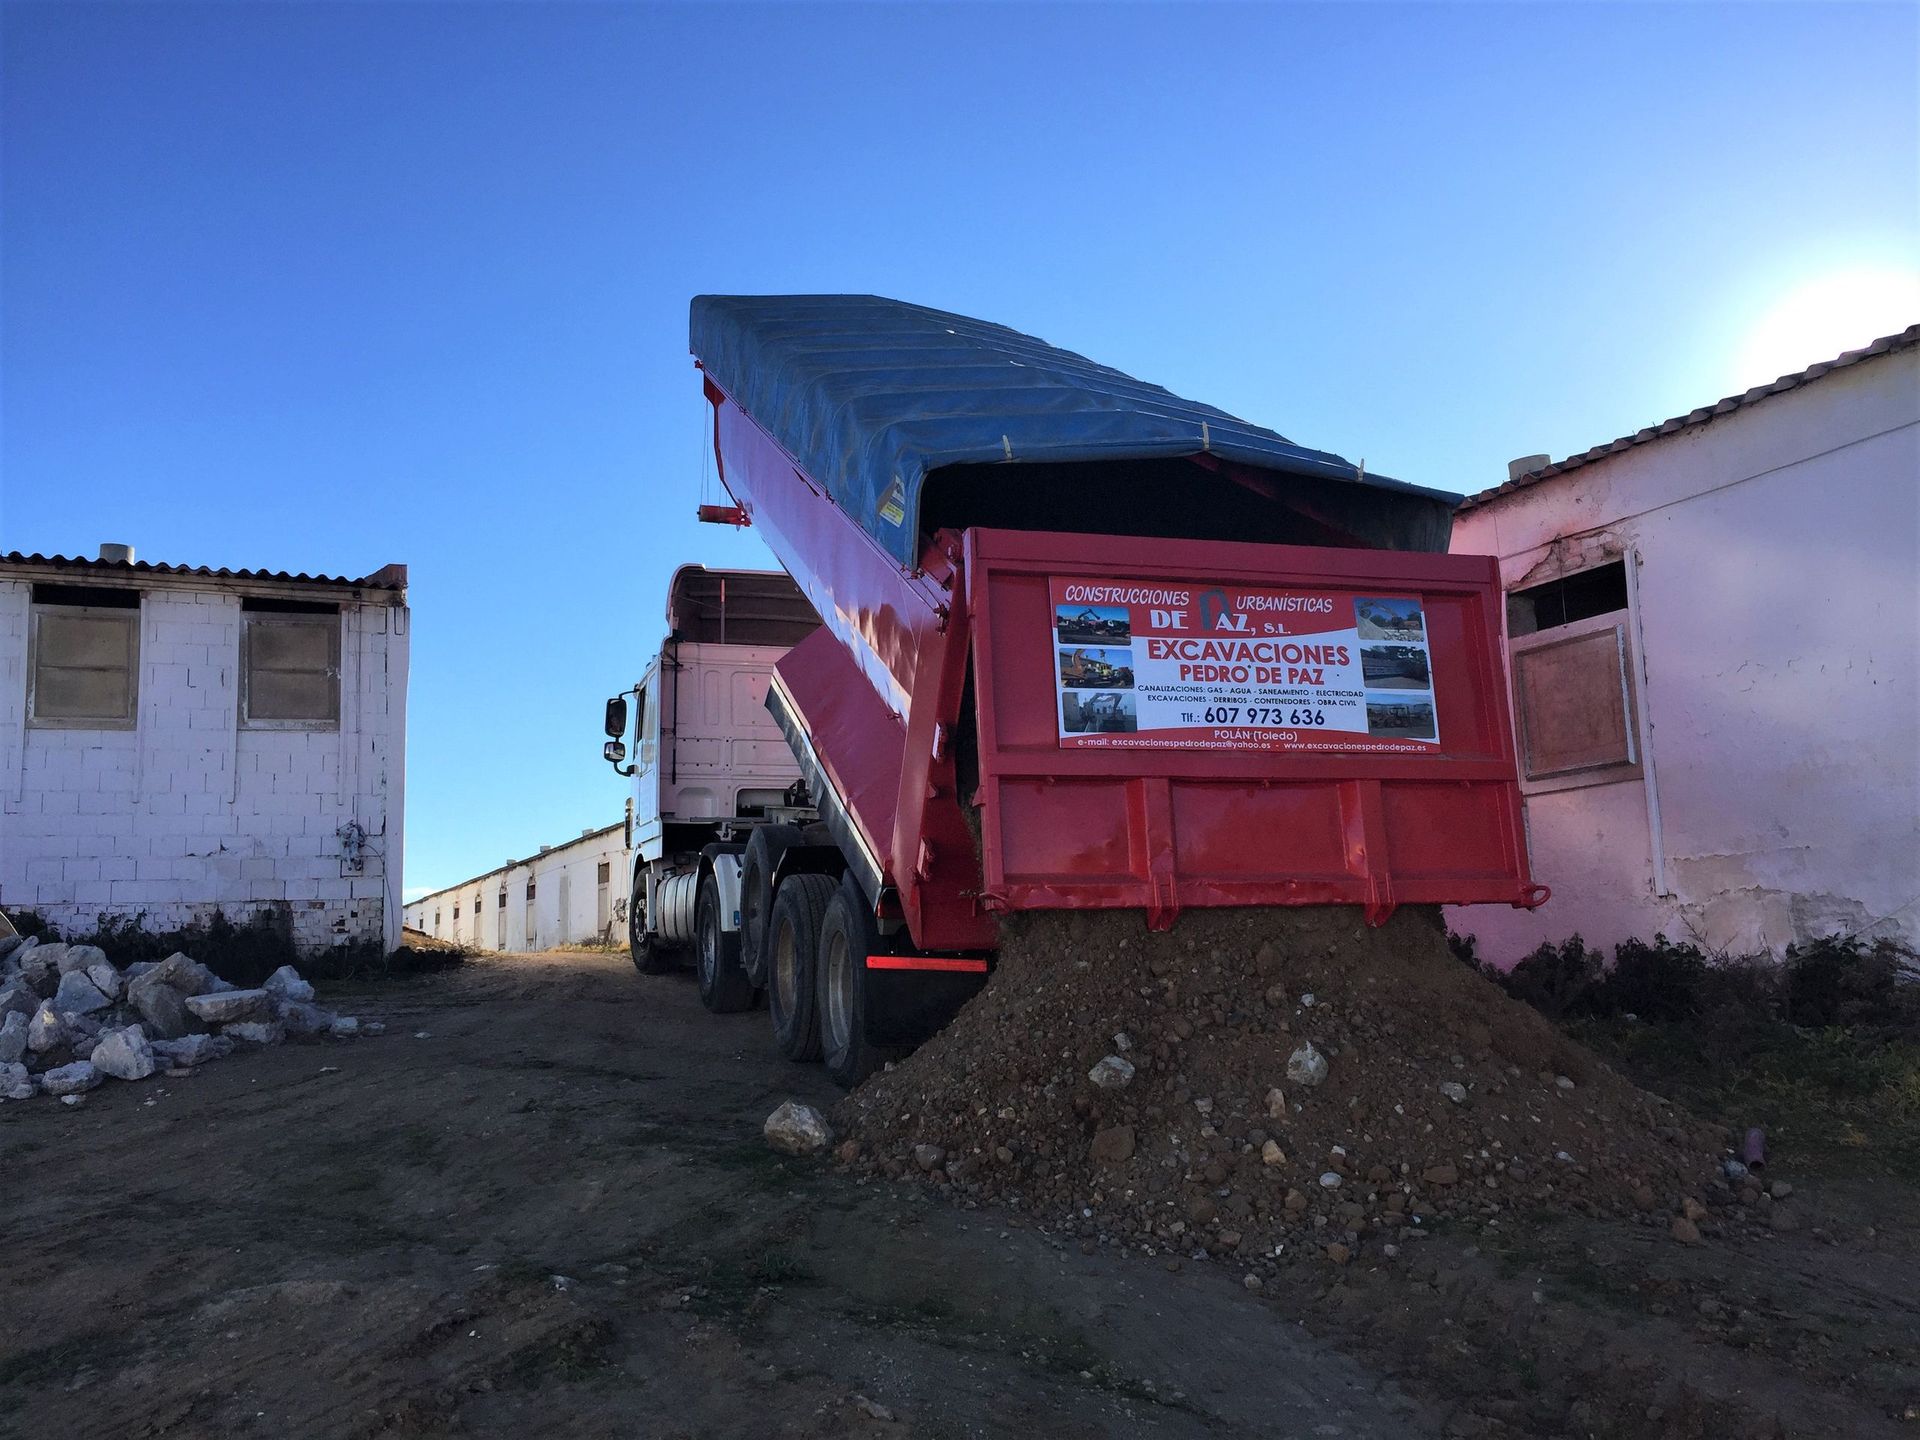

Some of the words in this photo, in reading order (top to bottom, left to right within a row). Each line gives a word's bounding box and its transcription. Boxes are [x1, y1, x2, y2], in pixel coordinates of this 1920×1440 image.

[1065, 585, 1190, 606] CONSTRUCCIONES
[1236, 593, 1333, 613] URBANÍSTICAS
[1150, 609, 1189, 630] DE
[1264, 622, 1291, 634] S.L.
[1147, 639, 1350, 666] EXCAVACIONES
[1180, 664, 1249, 684] PEDRO
[1255, 667, 1282, 684] DE
[1288, 668, 1325, 685] PAZ
[1138, 685, 1206, 693] CANALIZACIONES:
[1230, 687, 1252, 695] AGUA
[1258, 688, 1309, 696] SANEAMIENTO
[1316, 690, 1364, 698] ELECTRICIDAD
[1147, 694, 1207, 703] EXCAVACIONES
[1213, 696, 1248, 704] DERRIBOS
[1254, 697, 1311, 705] CONTENEDORES
[1204, 706, 1240, 724] 607
[1246, 707, 1283, 725] 973
[1289, 708, 1325, 725] 636
[1214, 728, 1251, 740] POLÁN
[1253, 731, 1298, 742] (Toledo)
[1077, 738, 1110, 746] e-mail:
[1284, 742, 1427, 752] www.excavacionespedrodepaz.es
